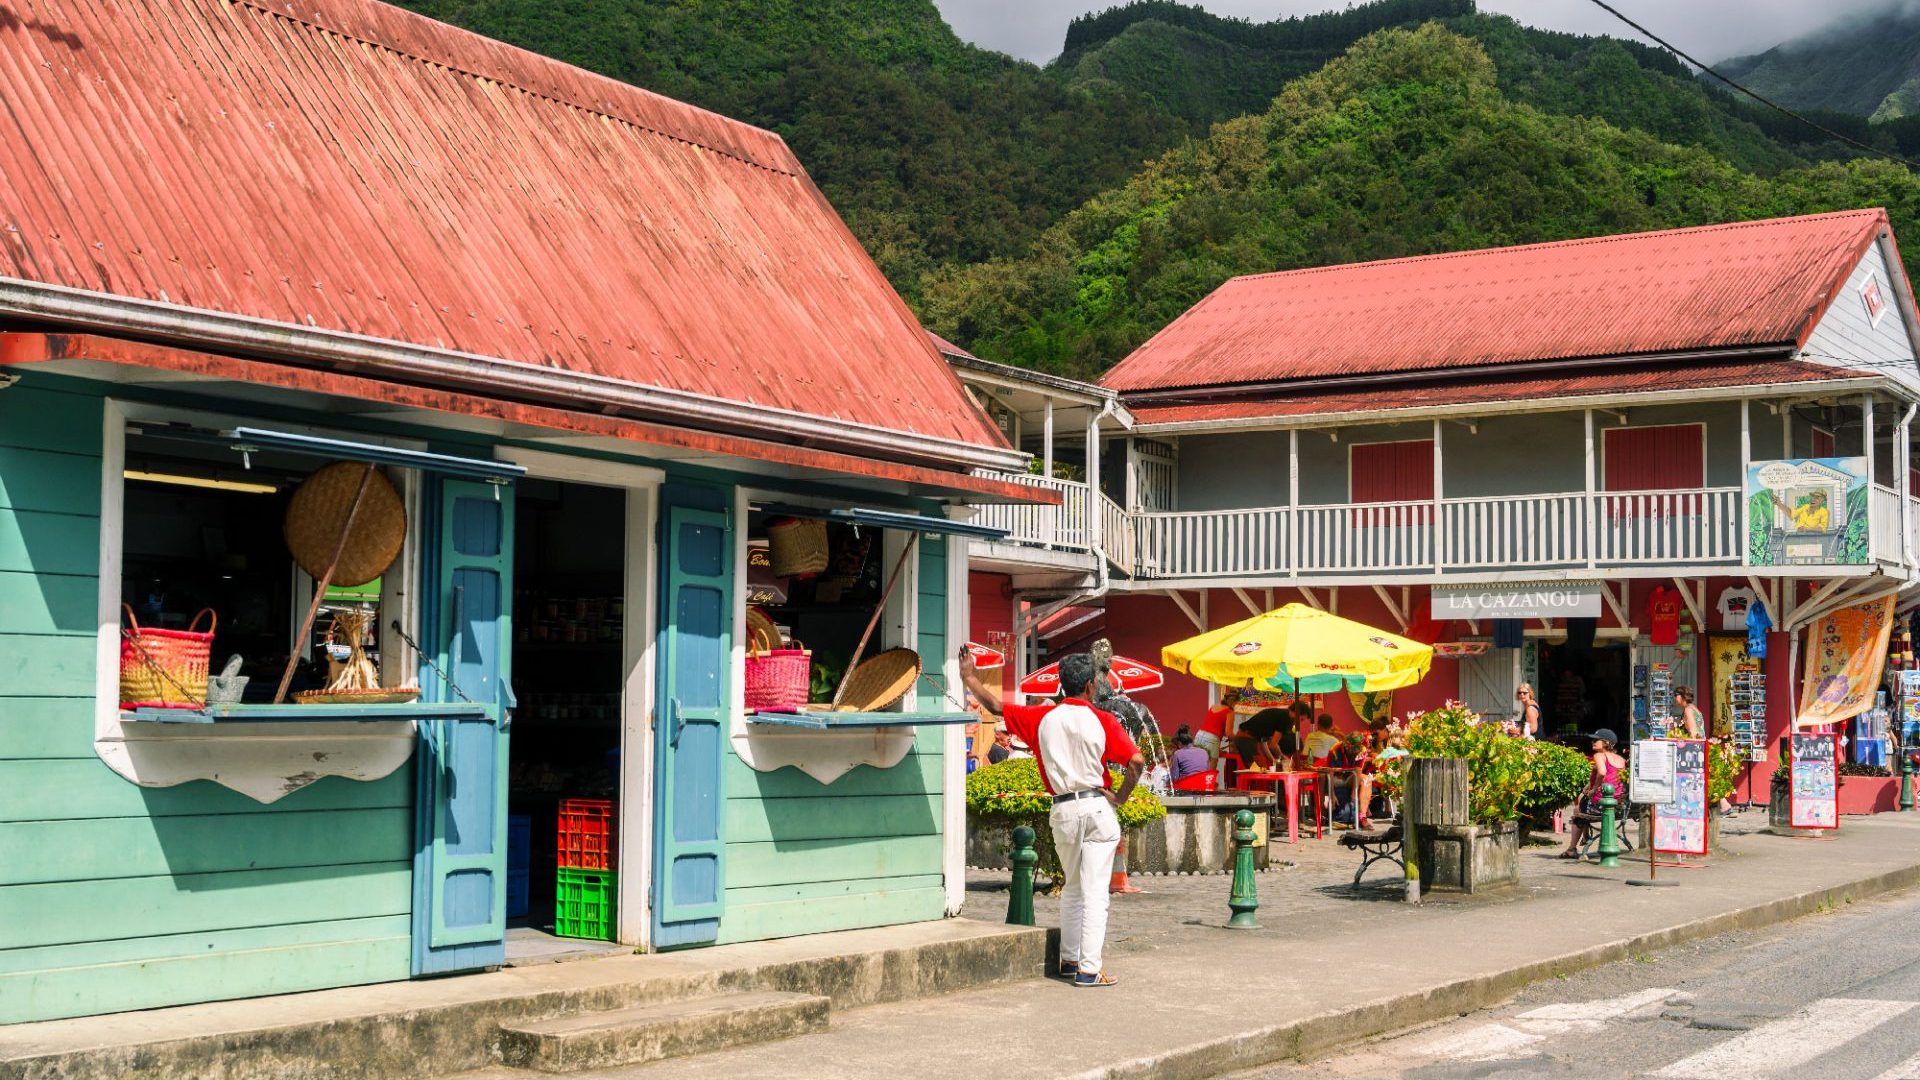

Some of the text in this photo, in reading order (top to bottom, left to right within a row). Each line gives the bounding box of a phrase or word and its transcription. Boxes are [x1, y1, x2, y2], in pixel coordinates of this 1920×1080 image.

[753, 590, 775, 602] Café
[1449, 590, 1581, 609] LA CAZANOU
